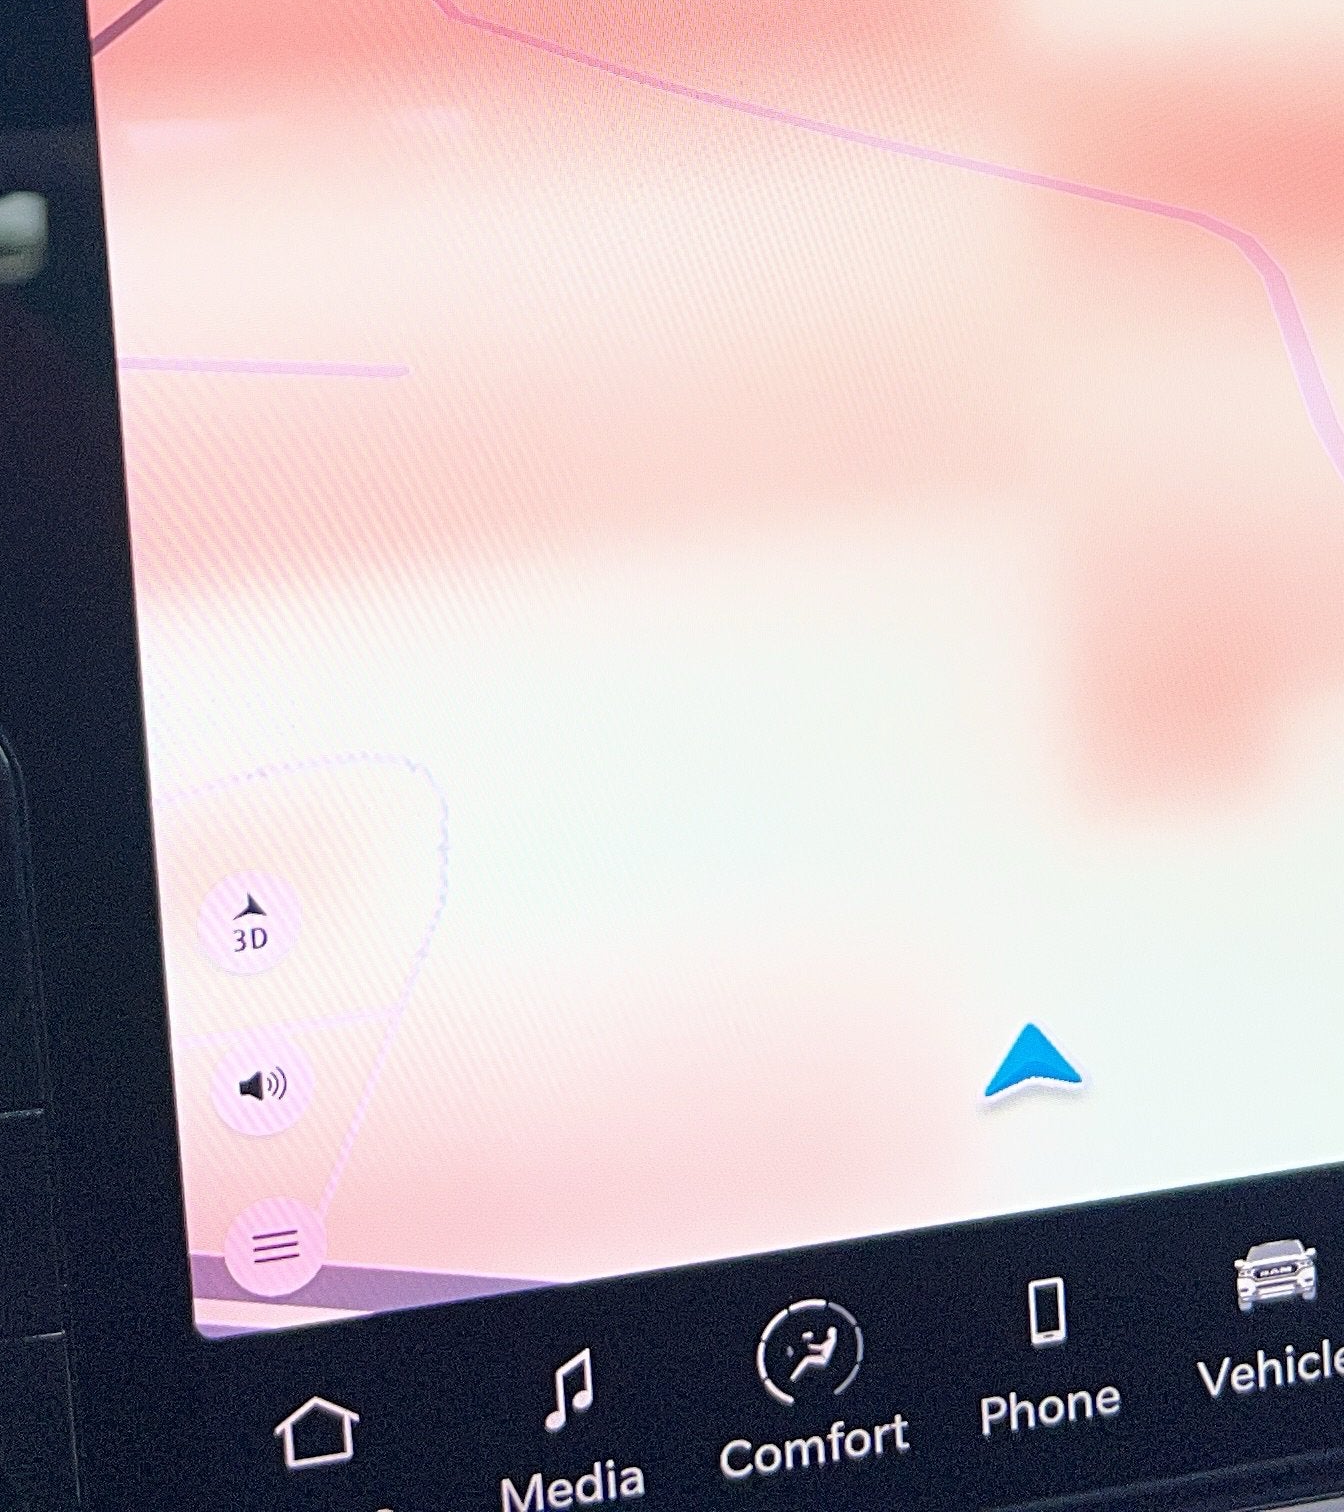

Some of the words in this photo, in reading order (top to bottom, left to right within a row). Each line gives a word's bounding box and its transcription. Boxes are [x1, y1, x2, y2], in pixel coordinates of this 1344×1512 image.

[233, 925, 269, 953] 3D
[980, 1385, 1122, 1436] Phone
[719, 1413, 911, 1479] Comfort
[501, 1459, 647, 1512] Media
